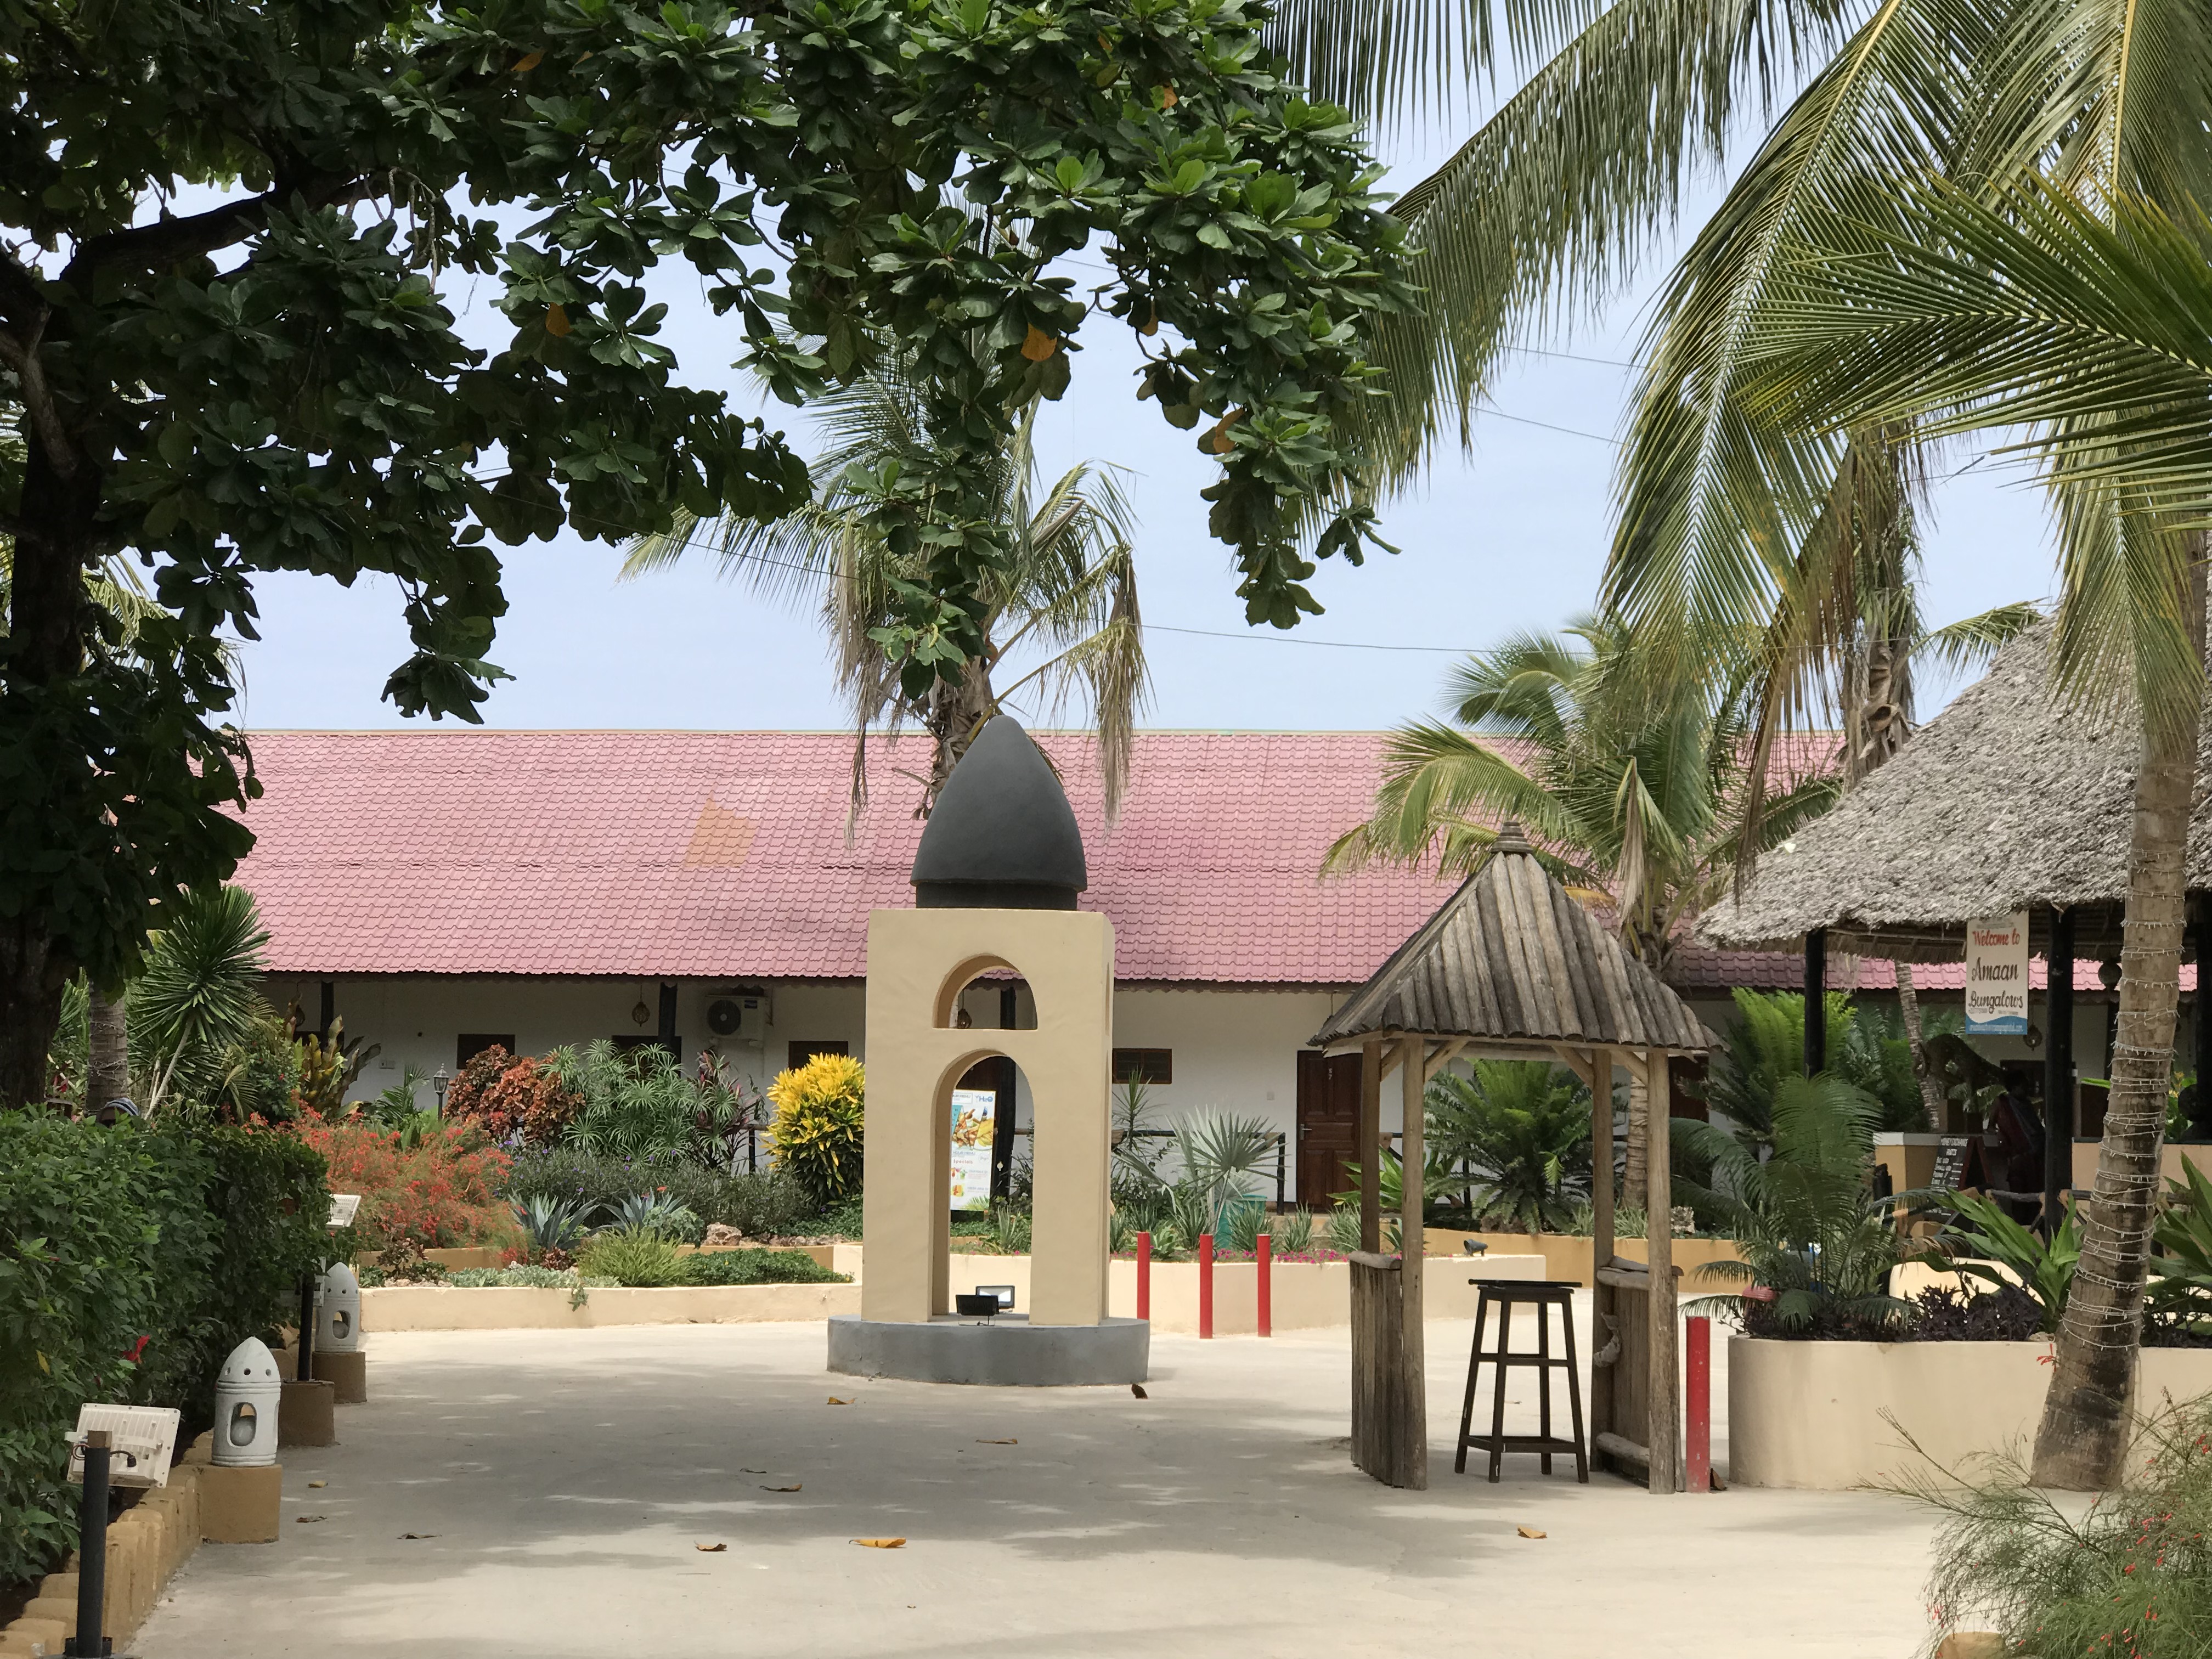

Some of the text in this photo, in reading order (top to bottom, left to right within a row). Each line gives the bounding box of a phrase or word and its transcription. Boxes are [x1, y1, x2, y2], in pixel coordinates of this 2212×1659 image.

[1972, 927, 2021, 946] Welcome to
[1971, 956, 2019, 981] Amaan
[1968, 990, 2024, 1014] Bungalows
